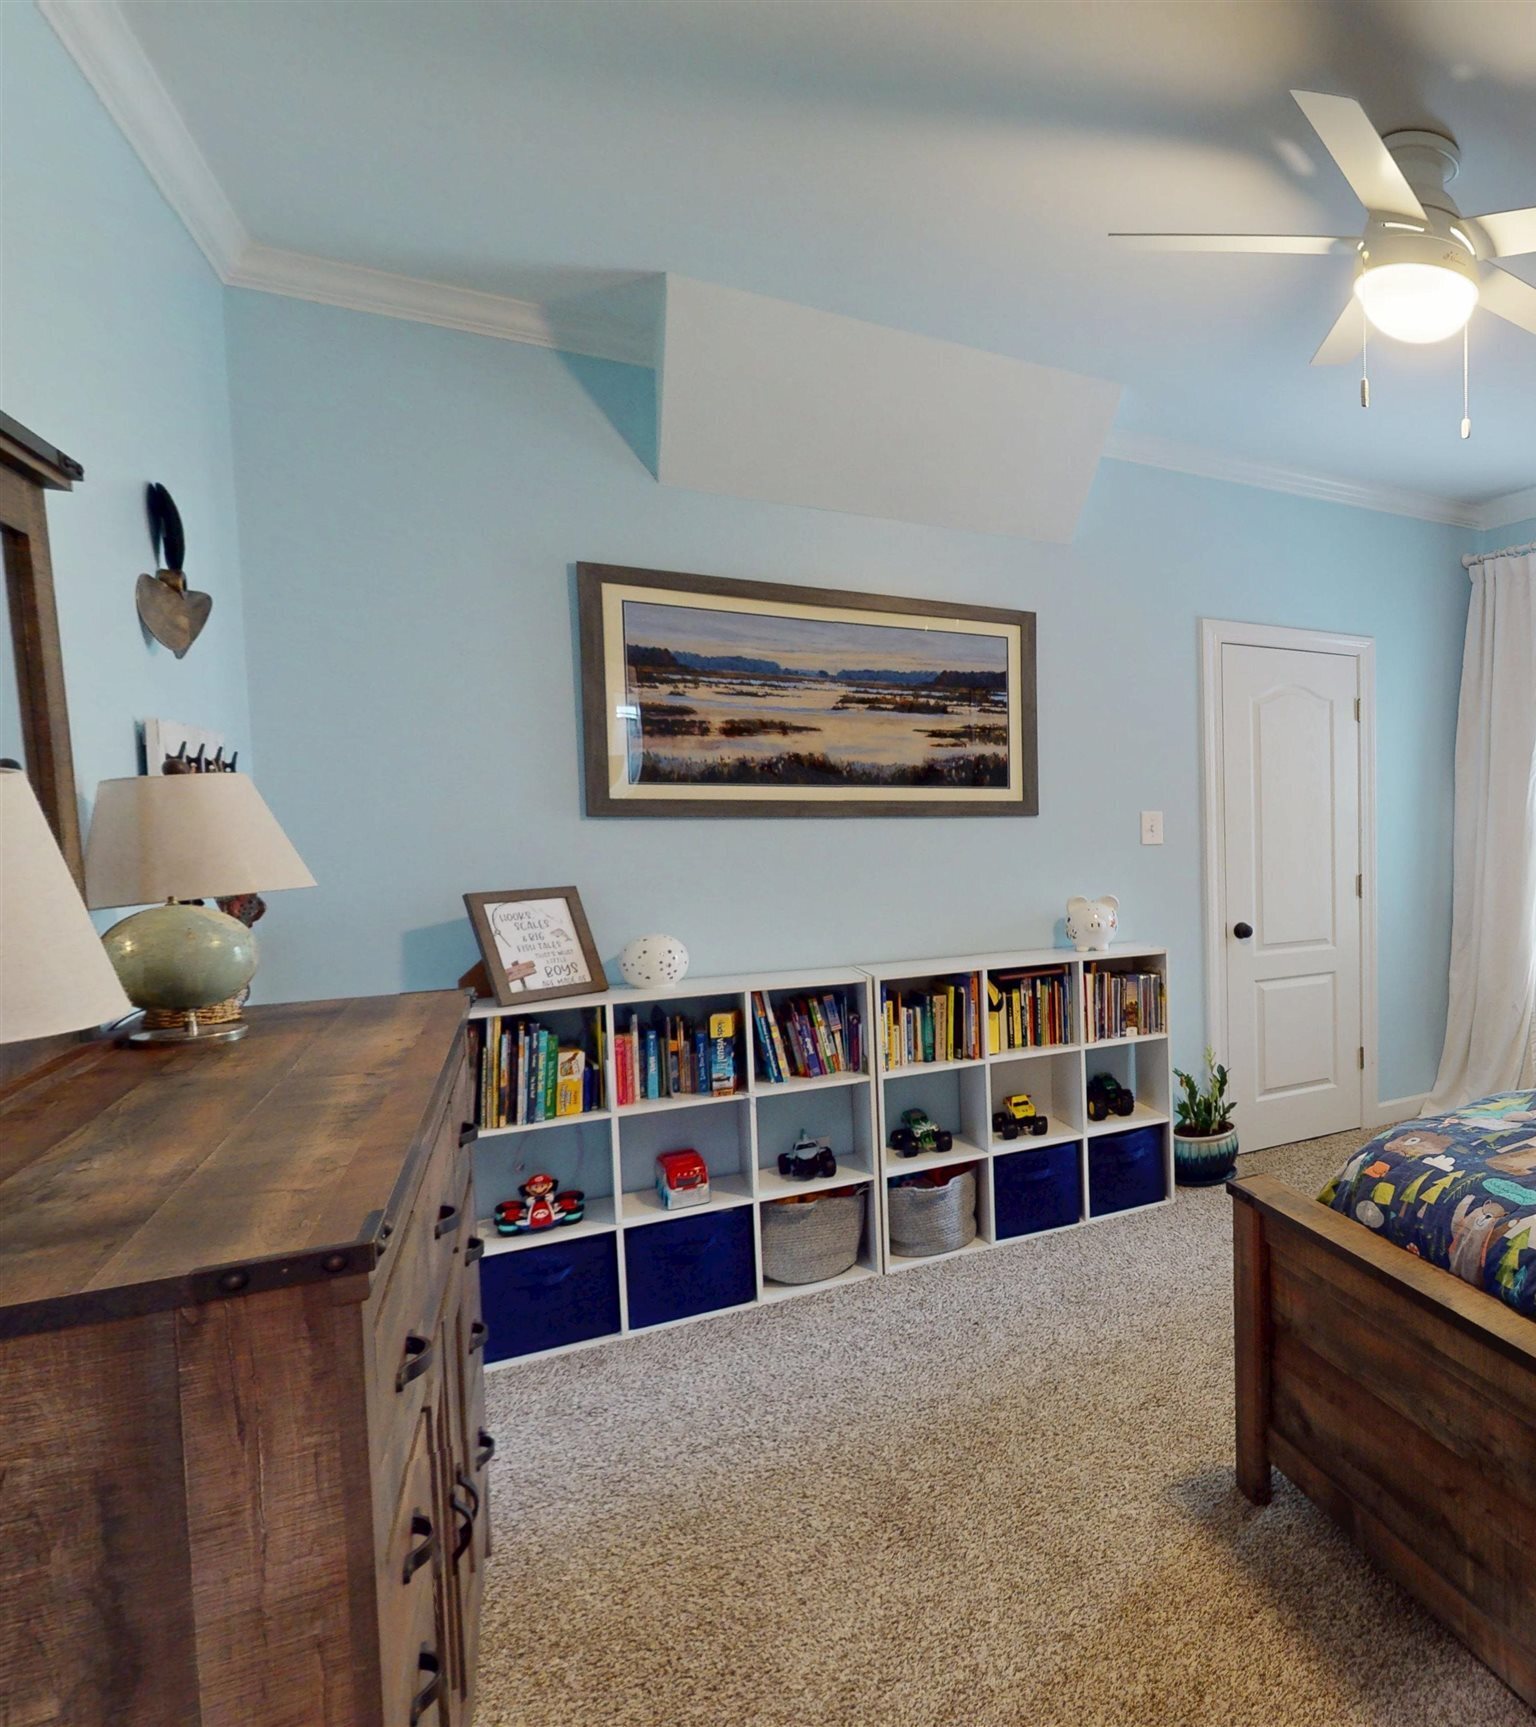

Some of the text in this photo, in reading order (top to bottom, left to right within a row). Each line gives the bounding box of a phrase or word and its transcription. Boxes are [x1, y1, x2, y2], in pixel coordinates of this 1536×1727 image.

[528, 932, 545, 941] BIG
[537, 941, 561, 950] TALES
[544, 962, 578, 978] BOYS
